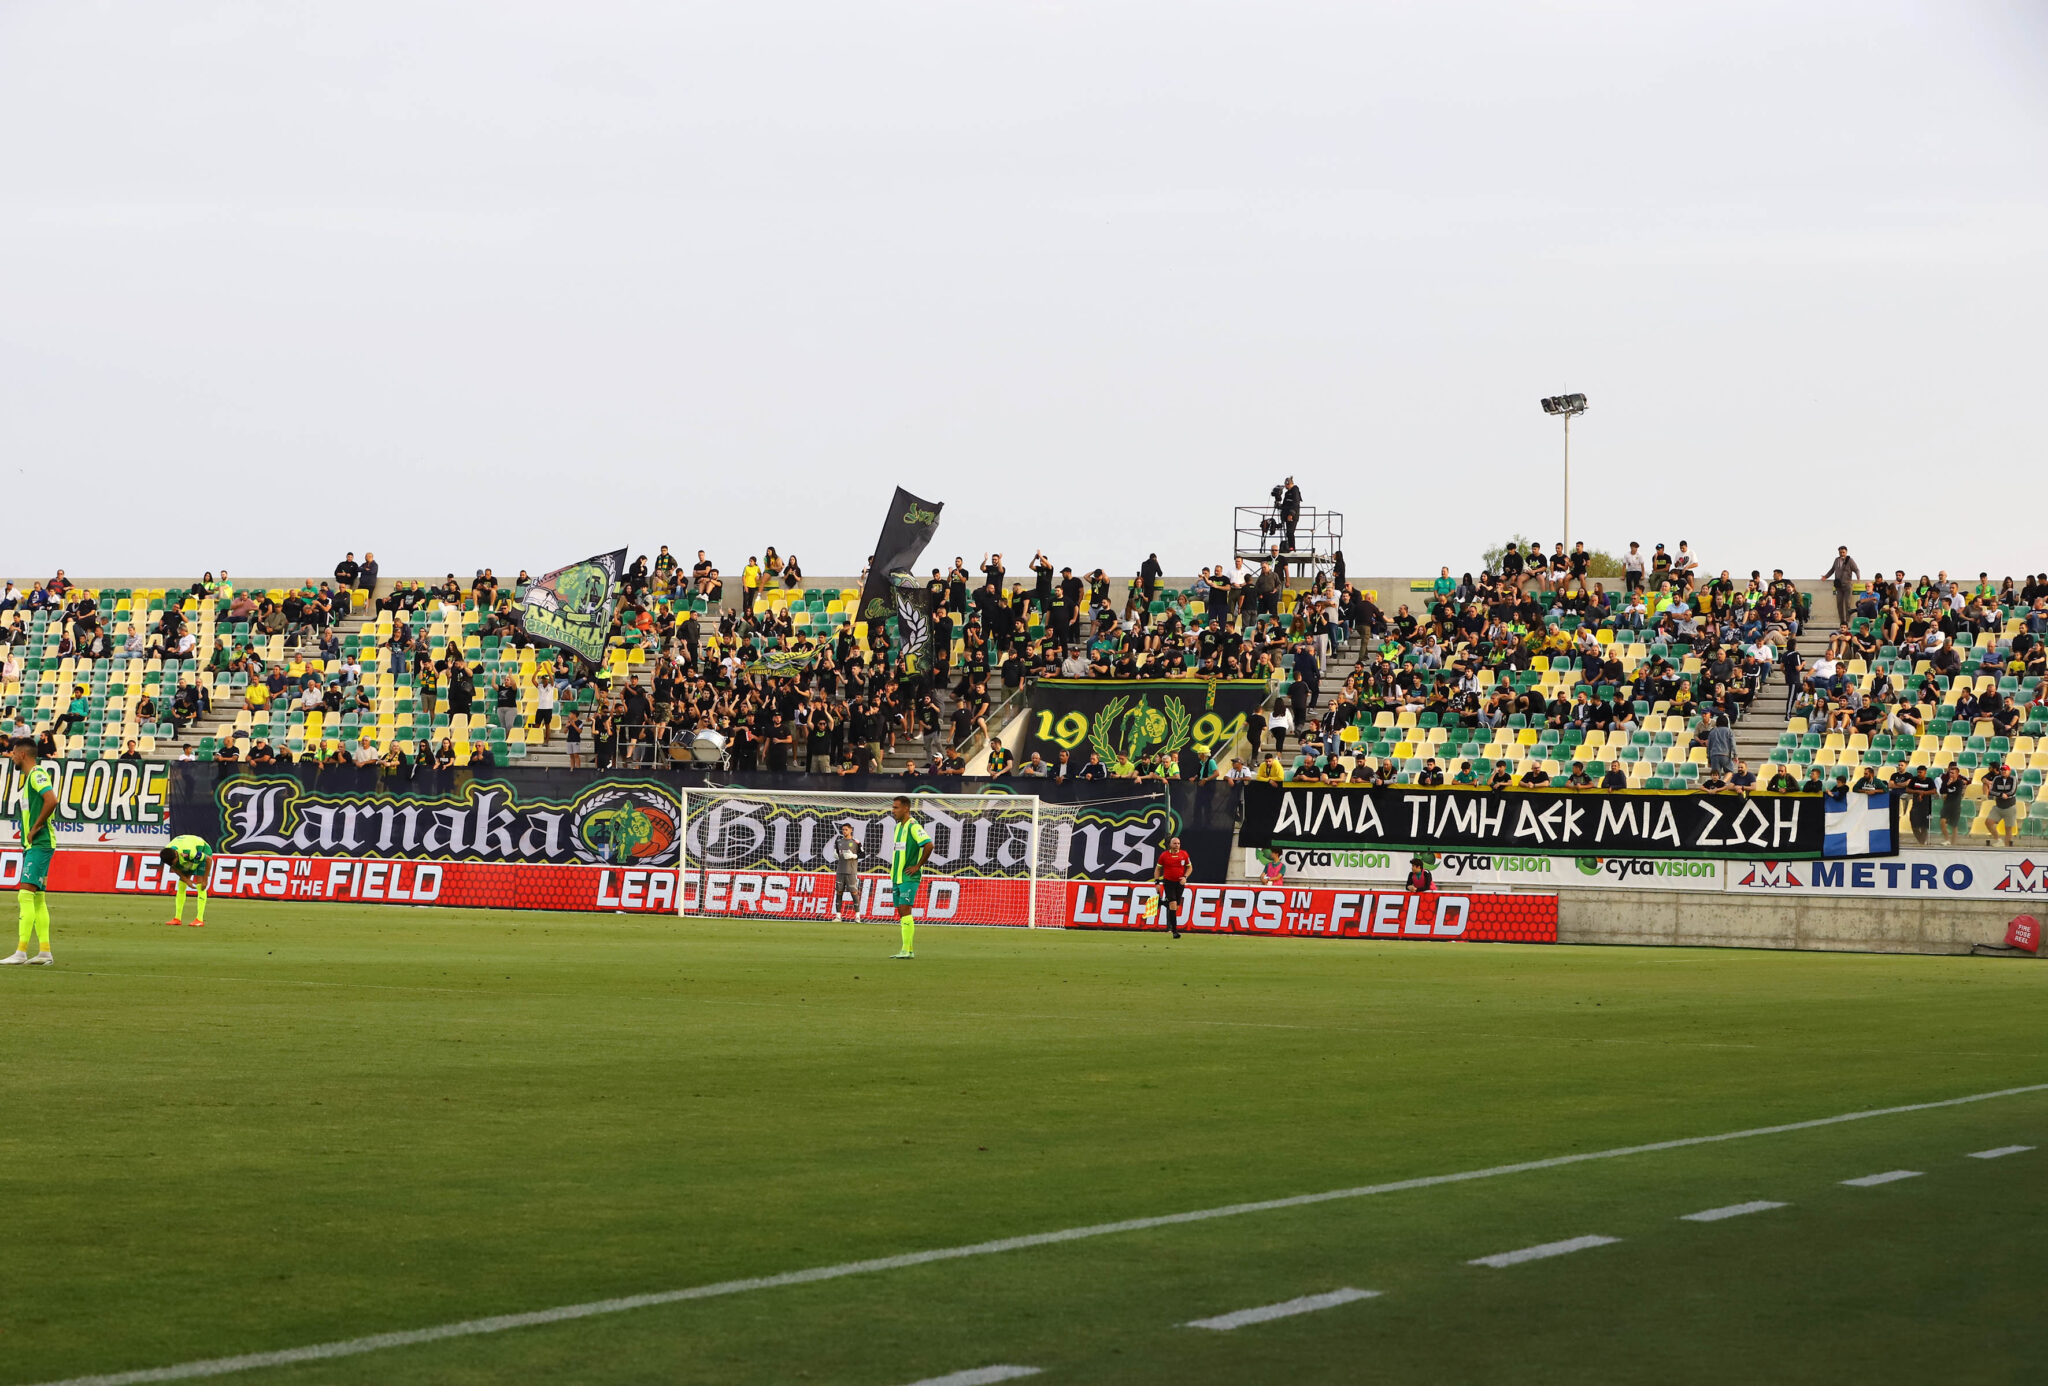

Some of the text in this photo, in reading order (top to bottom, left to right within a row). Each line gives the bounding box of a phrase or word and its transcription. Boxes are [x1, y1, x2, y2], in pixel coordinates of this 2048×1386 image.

[1036, 709, 1248, 753] 19 94
[97, 823, 171, 835] TOP KINISIS
[228, 786, 565, 857] Larnaka
[1273, 791, 1801, 848] ΑΙΜΑ ΤΙΜΗ ΑΕΚ ΜΙΑ ΖΩΗ
[293, 860, 312, 876] IN
[1285, 849, 1390, 872] cytavision
[1444, 853, 1551, 876] cytavision
[1606, 857, 1716, 880] cytavision
[325, 862, 443, 901] FIELD
[795, 876, 816, 893] IN
[1812, 861, 1973, 890] METRO
[290, 879, 324, 896] THE
[596, 870, 790, 912] LEADERS
[791, 896, 828, 914] THE
[1290, 891, 1312, 909] IN
[1286, 912, 1327, 931] THE
[1329, 893, 1470, 936] FIELD
[2015, 930, 2032, 939] HOSE
[2018, 924, 2032, 932] FIRE
[2014, 936, 2029, 944] REEL
